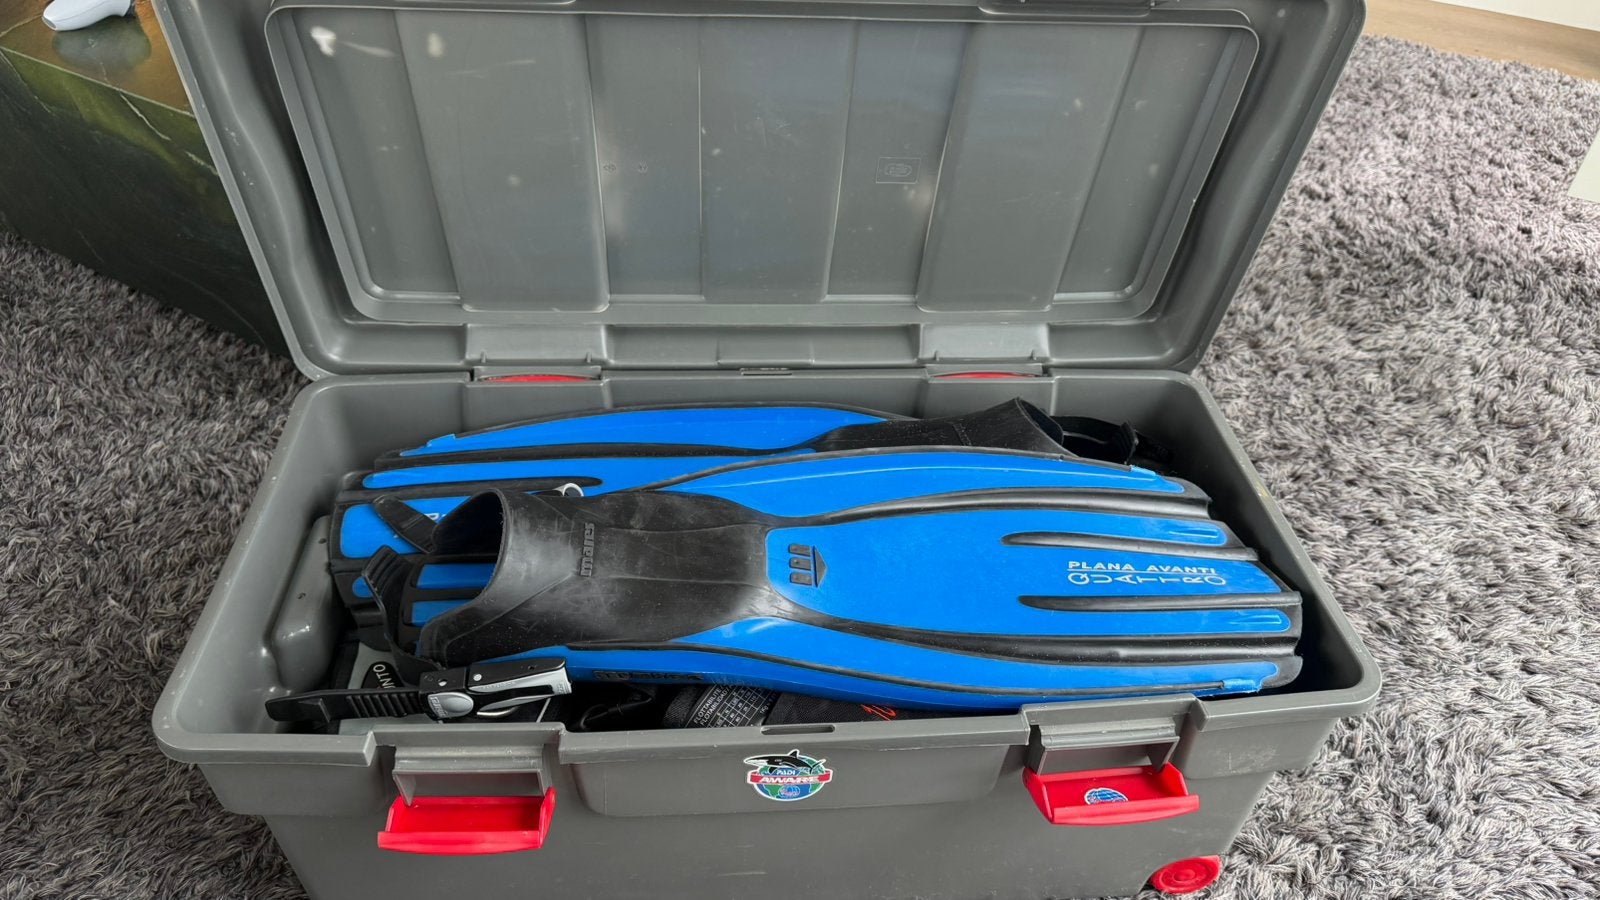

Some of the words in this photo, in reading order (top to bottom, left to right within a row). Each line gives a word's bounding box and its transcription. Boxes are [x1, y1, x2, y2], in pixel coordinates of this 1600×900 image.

[1068, 561, 1135, 571] PLANA
[1147, 565, 1218, 575] AVANTI
[1067, 572, 1227, 586] QUATTRO
[759, 776, 818, 784] AWARE
